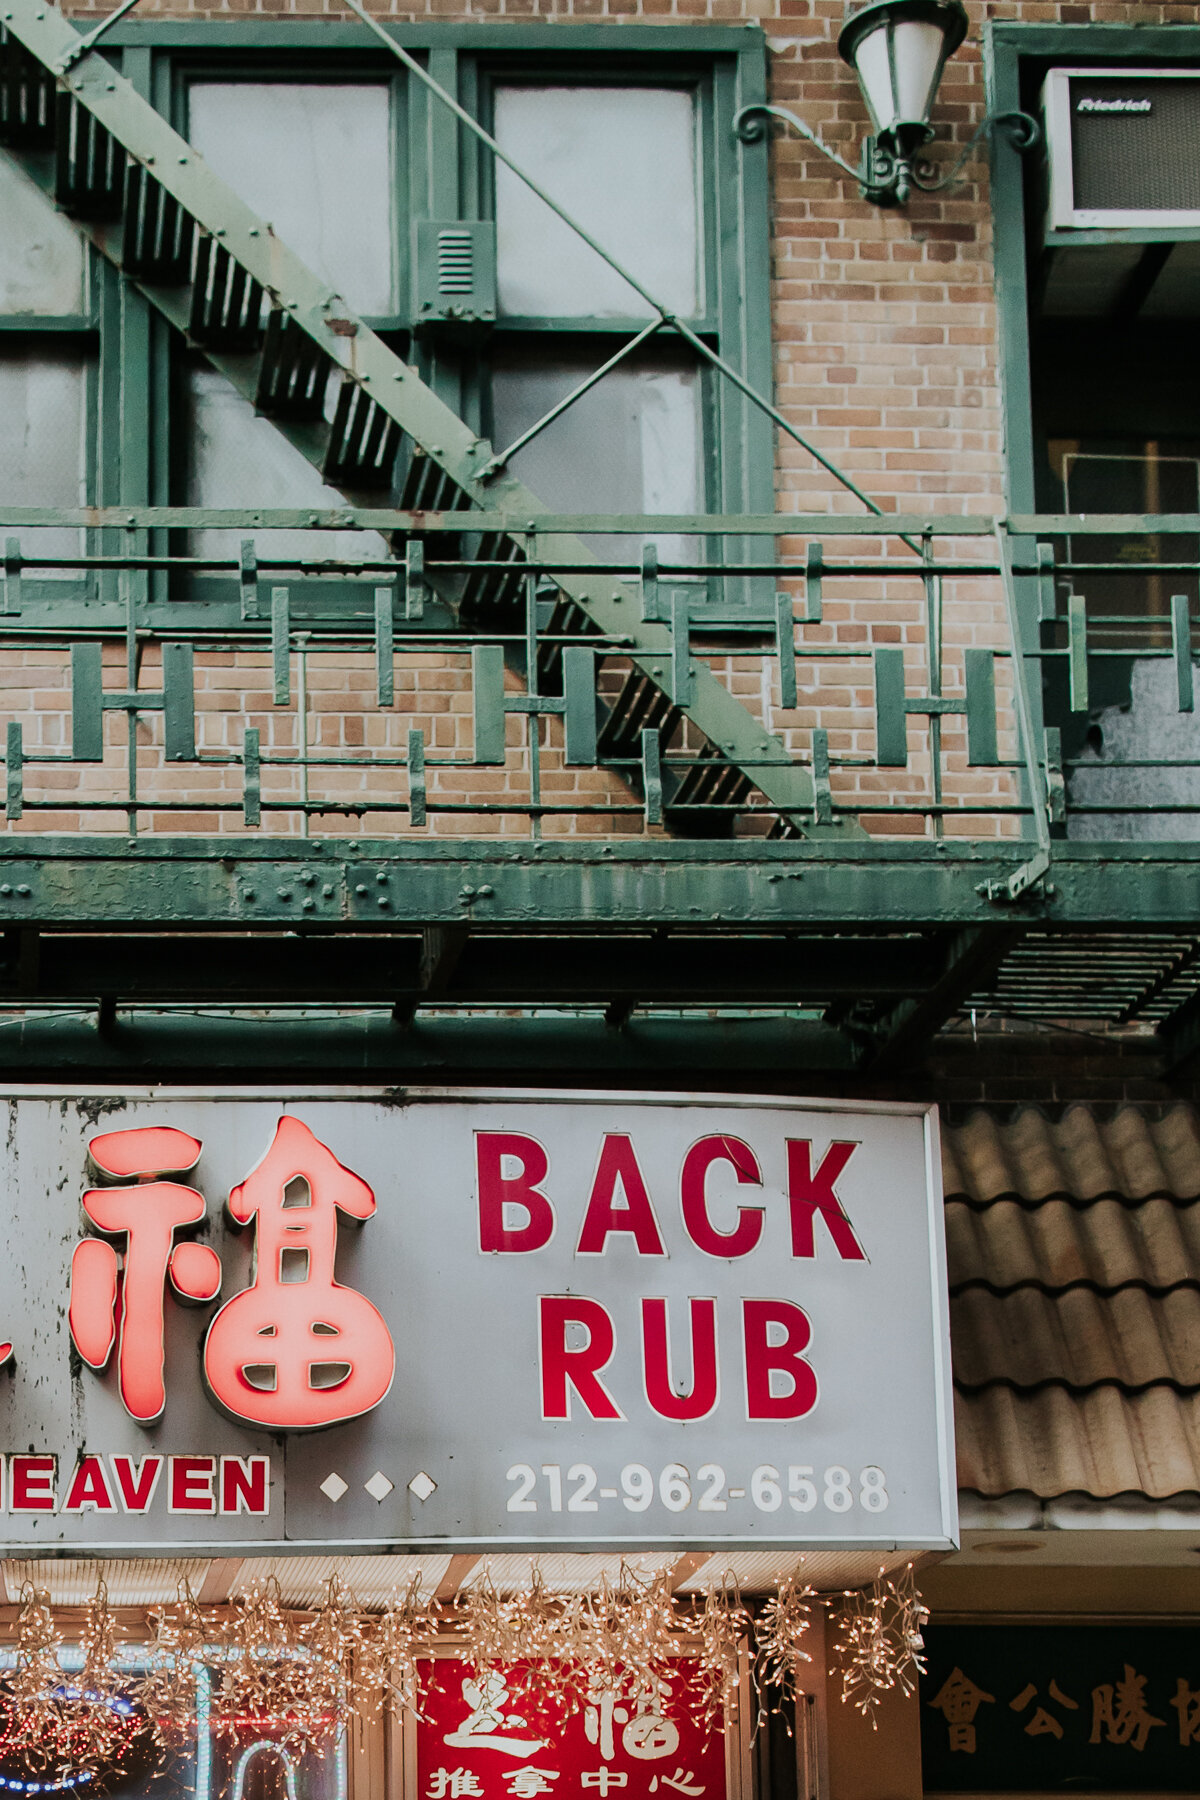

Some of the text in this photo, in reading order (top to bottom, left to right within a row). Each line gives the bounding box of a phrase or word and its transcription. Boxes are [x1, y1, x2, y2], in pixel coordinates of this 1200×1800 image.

[1076, 97, 1152, 112] Friedrich
[472, 1129, 871, 1264] BACK
[538, 1294, 821, 1424] RUB
[505, 1462, 892, 1516] 212-962-6588
[425, 1765, 706, 1799] 推拿中心
